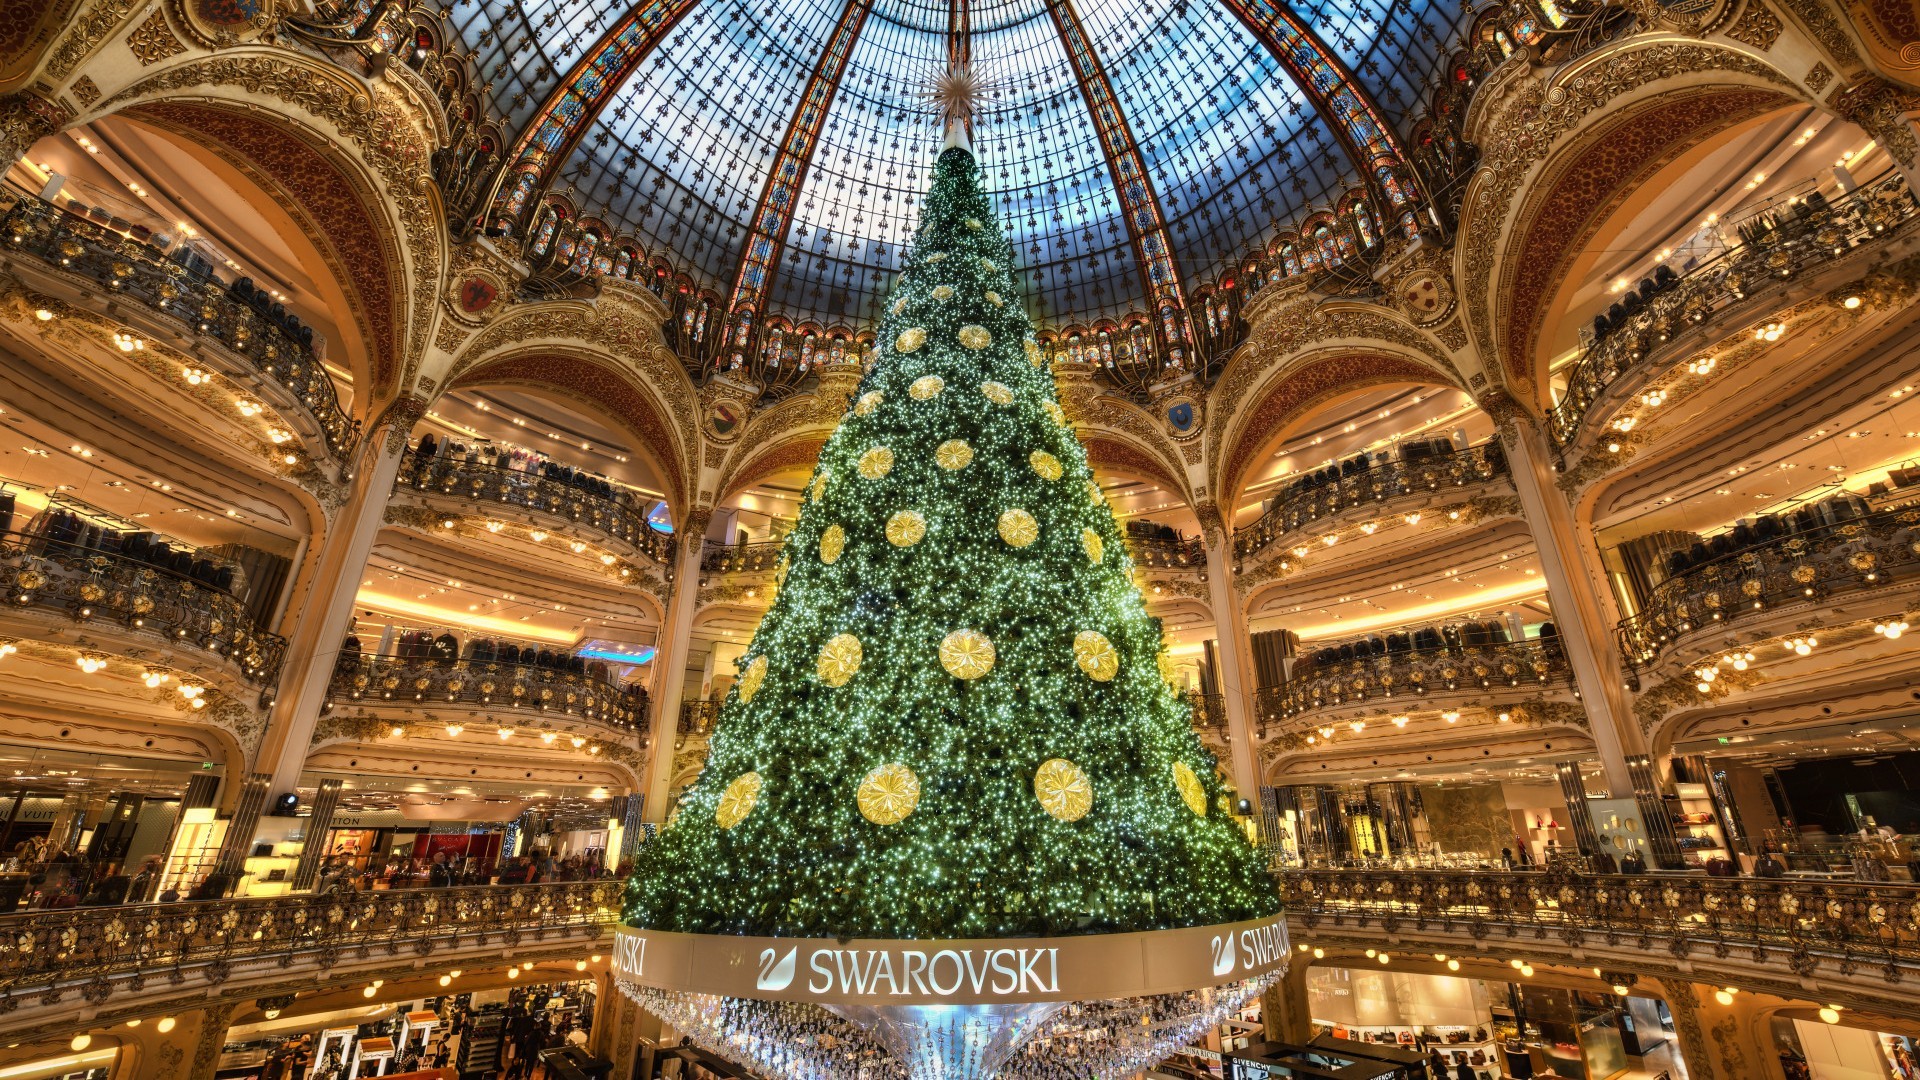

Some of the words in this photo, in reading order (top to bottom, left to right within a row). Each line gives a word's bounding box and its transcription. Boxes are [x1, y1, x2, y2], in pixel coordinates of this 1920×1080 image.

[808, 948, 1061, 996] SWAROVSKI
[1184, 1046, 1200, 1057] NINA
[1200, 1050, 1219, 1060] RICCI
[1232, 1057, 1271, 1071] GIVENCHY
[1370, 1071, 1395, 1080] VENCHY
